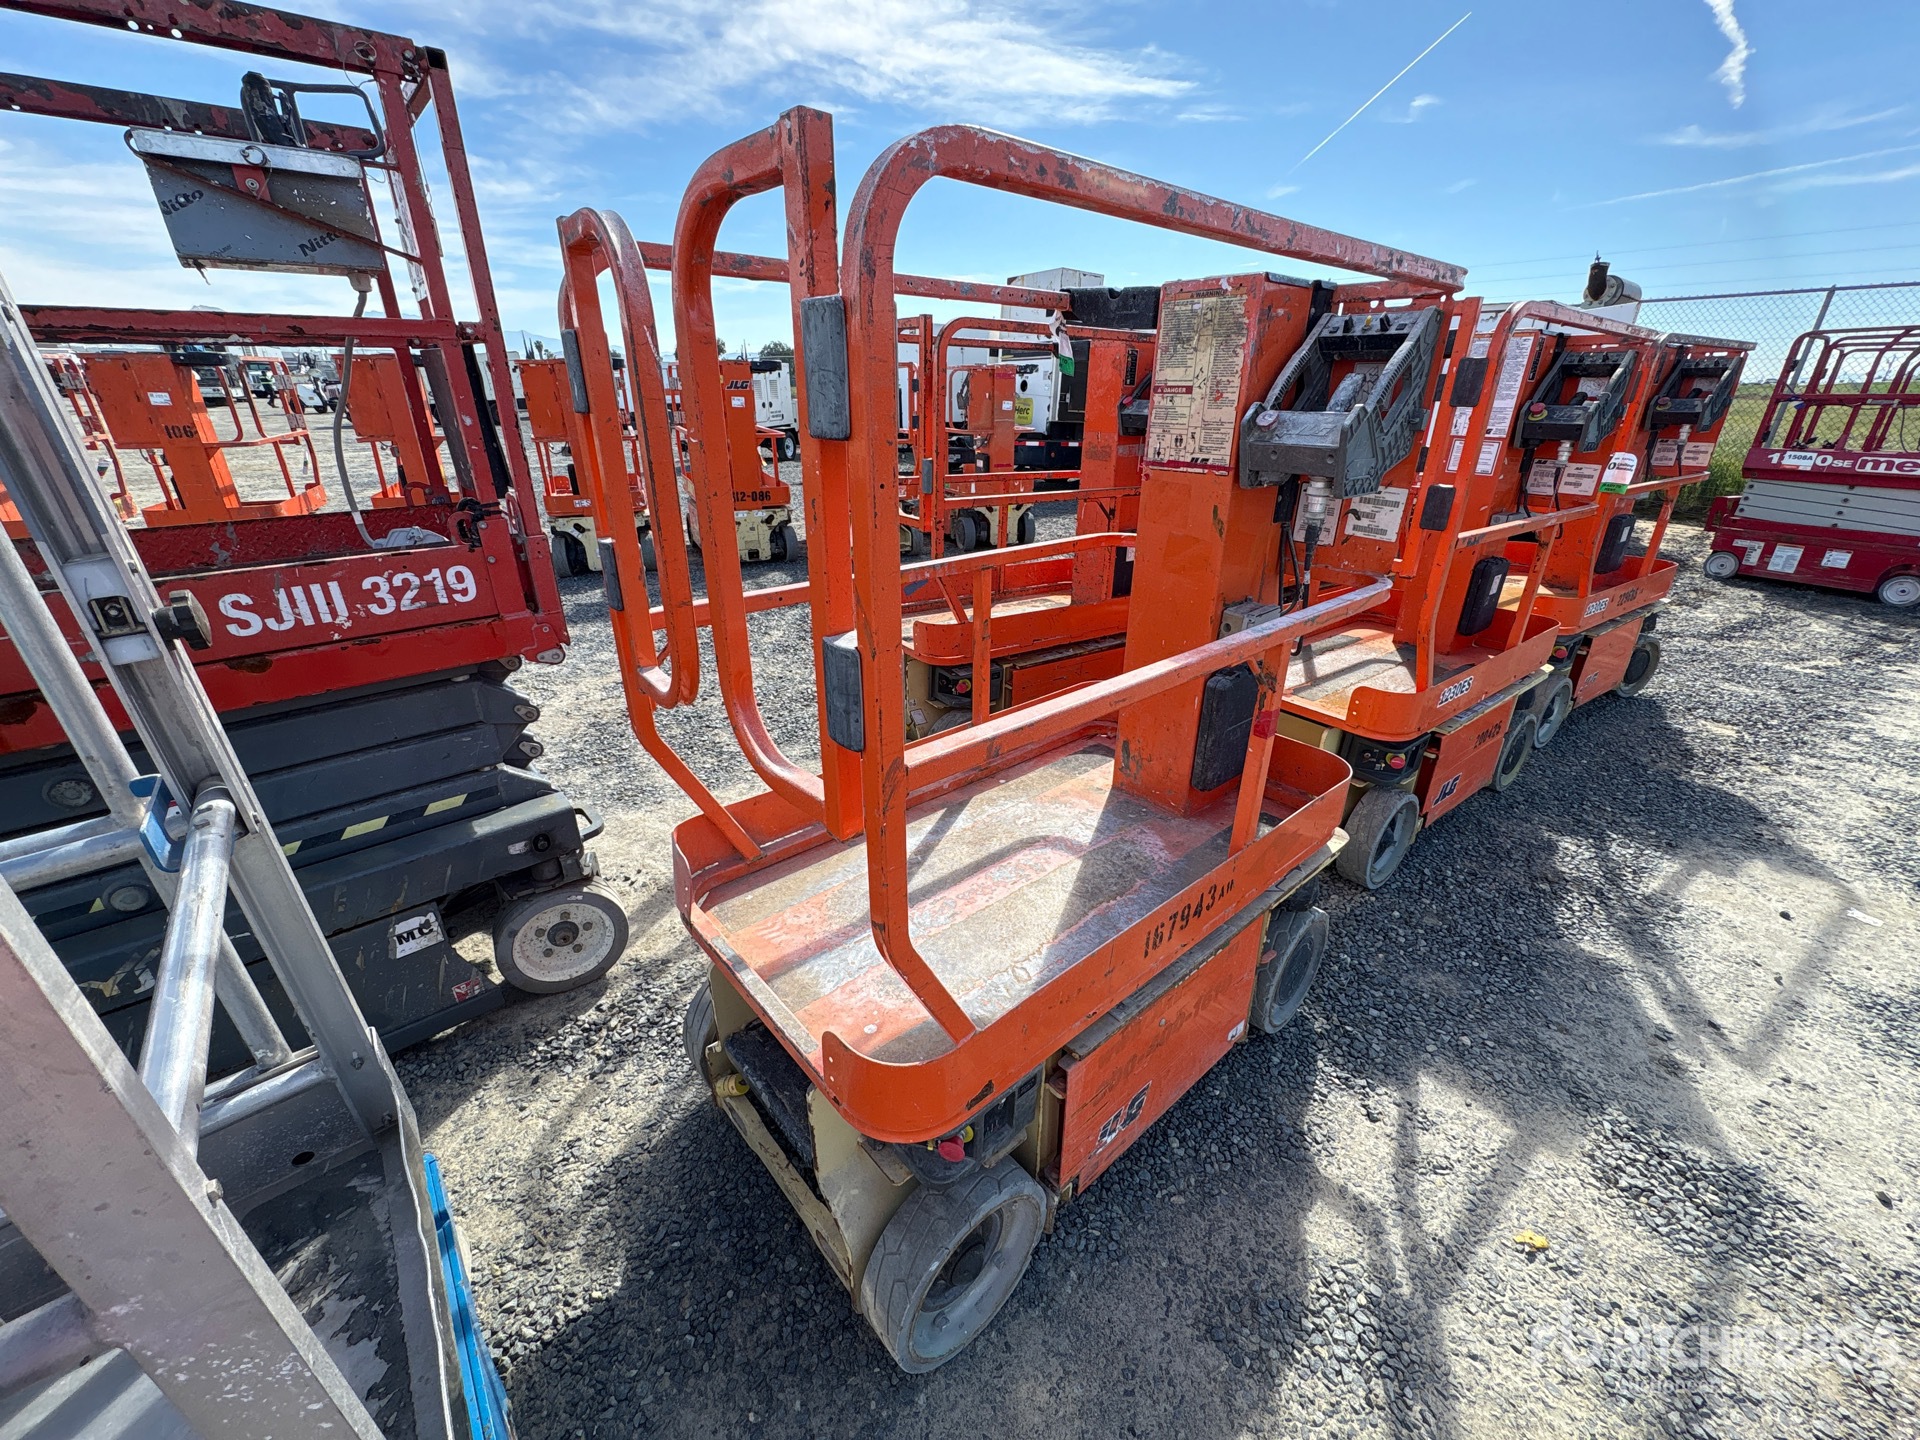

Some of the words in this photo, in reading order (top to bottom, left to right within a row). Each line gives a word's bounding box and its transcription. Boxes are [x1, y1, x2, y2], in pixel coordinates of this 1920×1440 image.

[726, 380, 750, 390] JLG
[1787, 453, 1813, 461] 1508A
[361, 564, 478, 617] 3219
[1437, 676, 1474, 707] 1230ES
[1432, 772, 1462, 807] JLG
